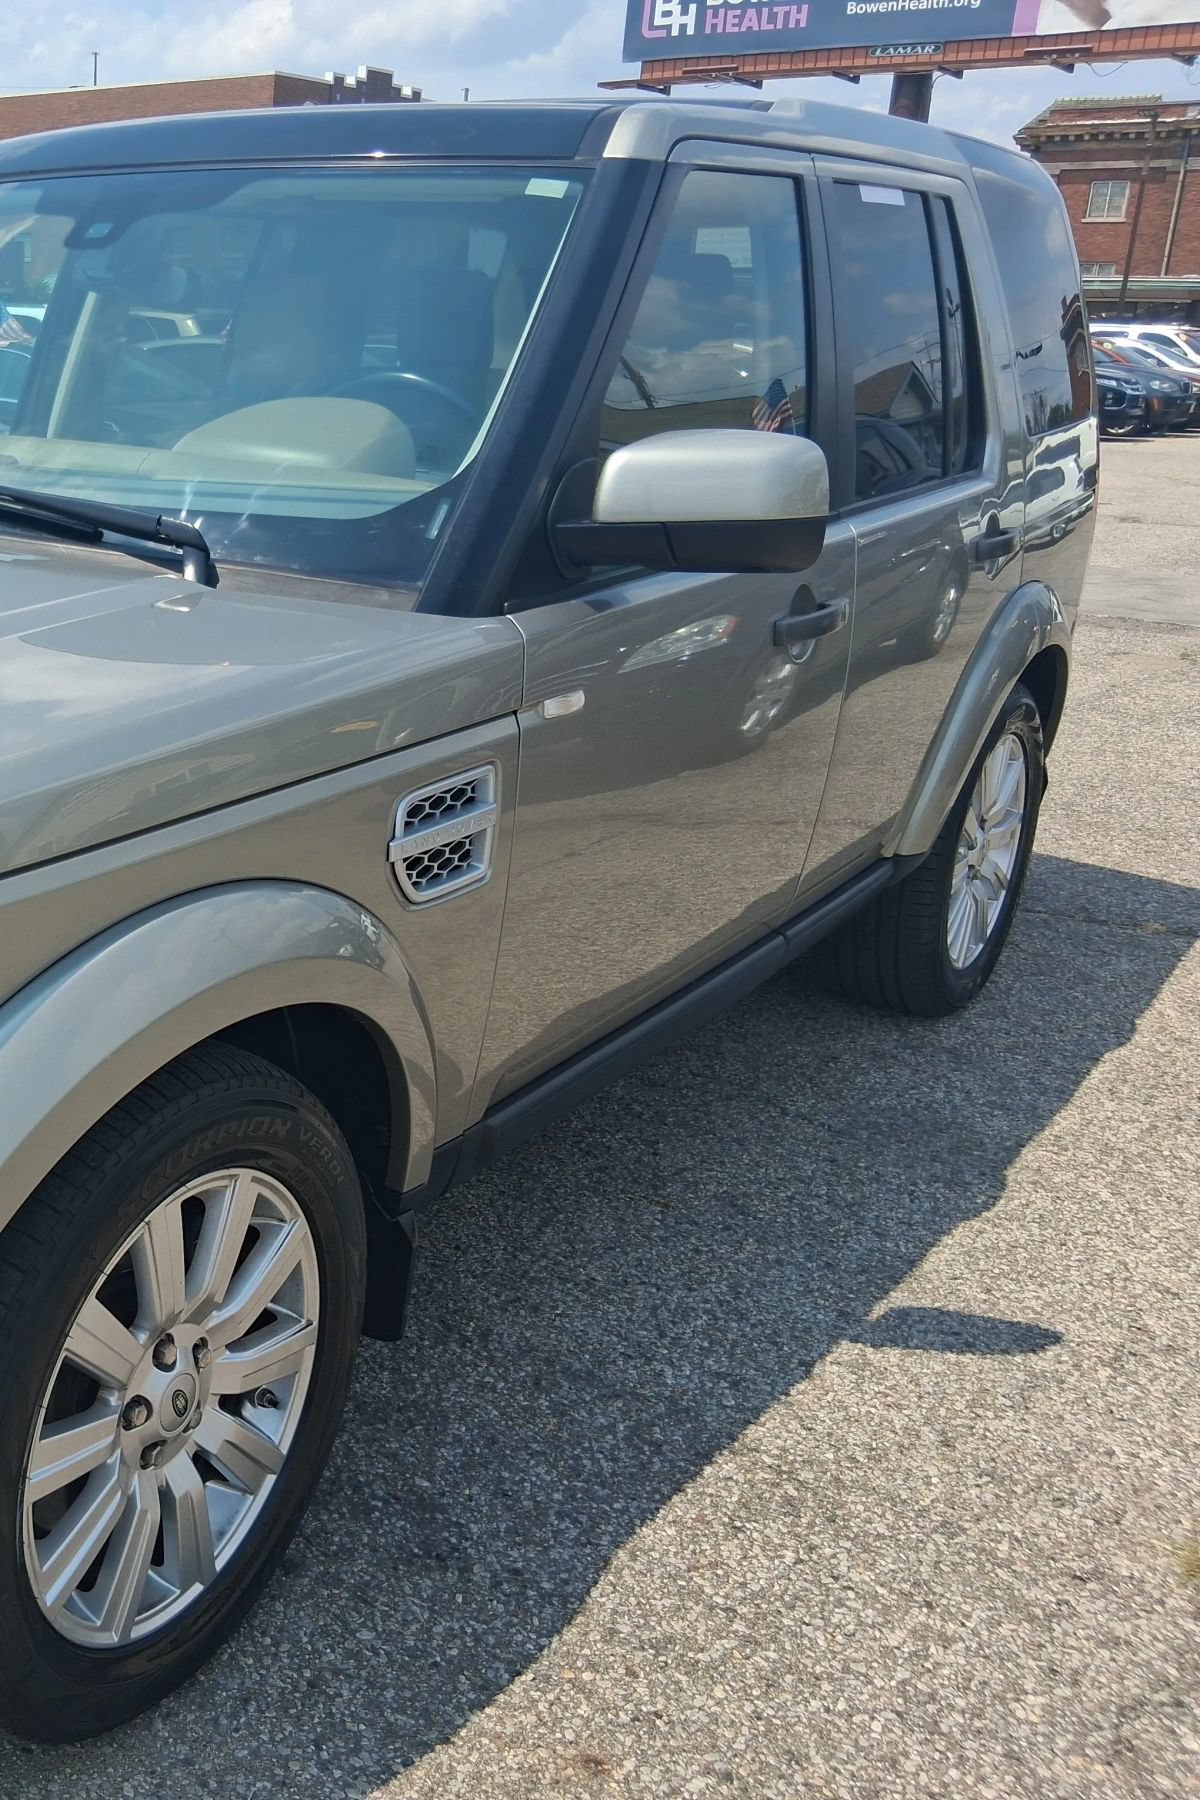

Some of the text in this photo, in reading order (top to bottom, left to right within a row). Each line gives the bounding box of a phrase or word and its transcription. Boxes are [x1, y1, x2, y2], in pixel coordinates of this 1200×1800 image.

[846, 0, 981, 14] BowenHealth.org
[704, 5, 808, 34] HEALTH
[874, 45, 935, 55] LAMAR
